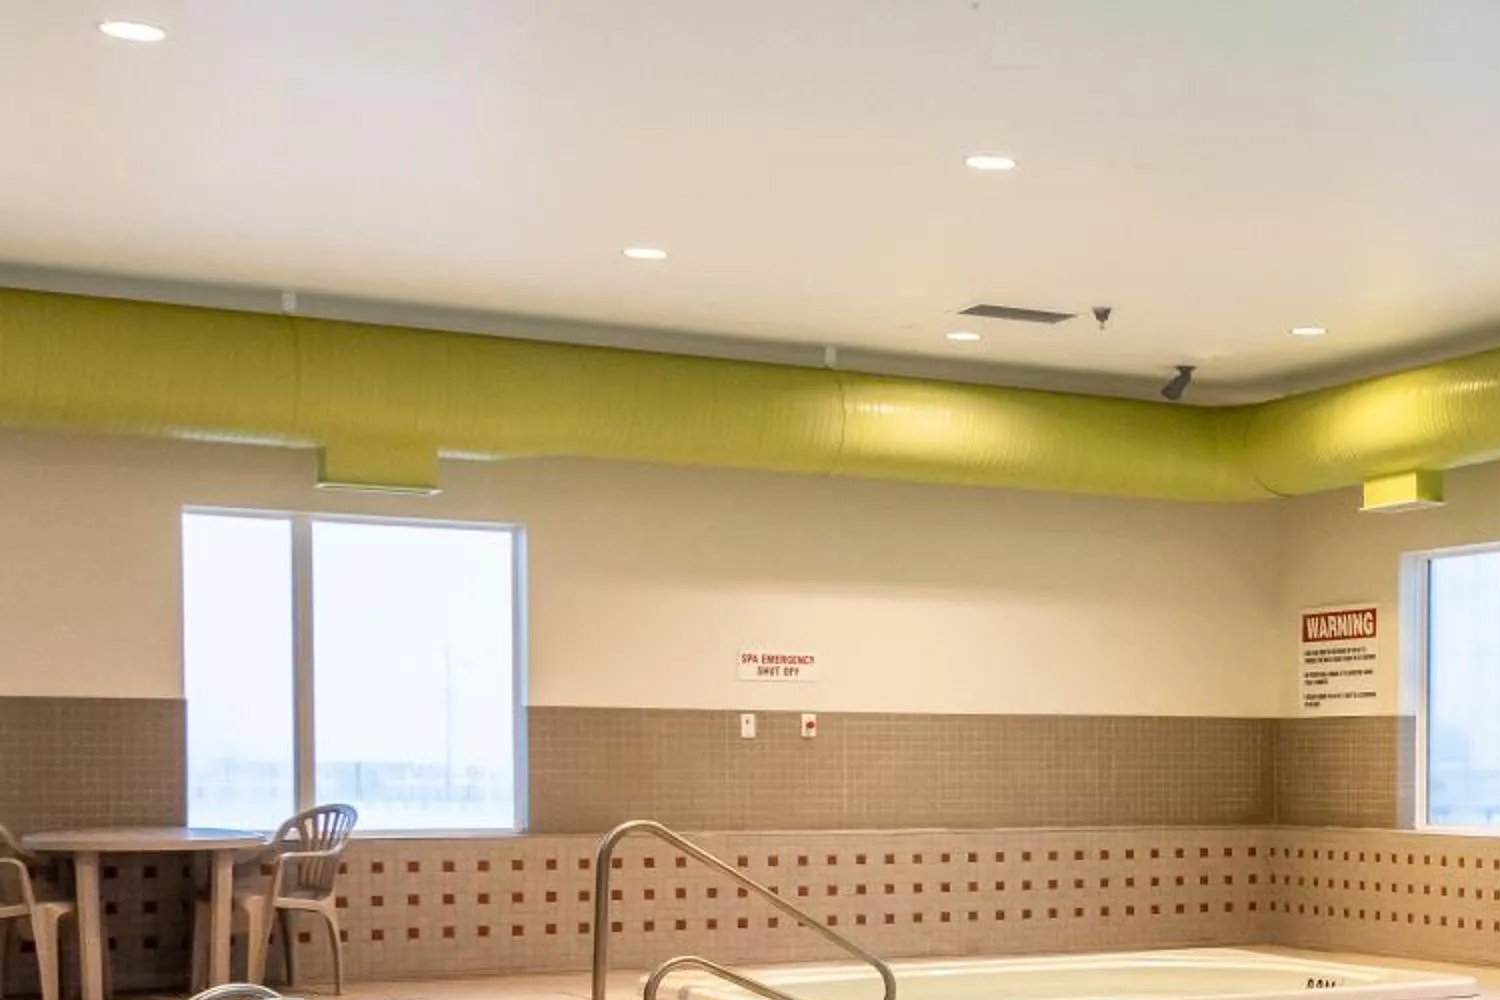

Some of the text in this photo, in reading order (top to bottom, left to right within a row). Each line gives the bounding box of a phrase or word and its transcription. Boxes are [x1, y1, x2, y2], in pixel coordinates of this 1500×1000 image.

[1306, 611, 1374, 639] WARNING
[741, 653, 815, 665] SPA EMERGENCY
[757, 666, 800, 677] SHUT OFF
